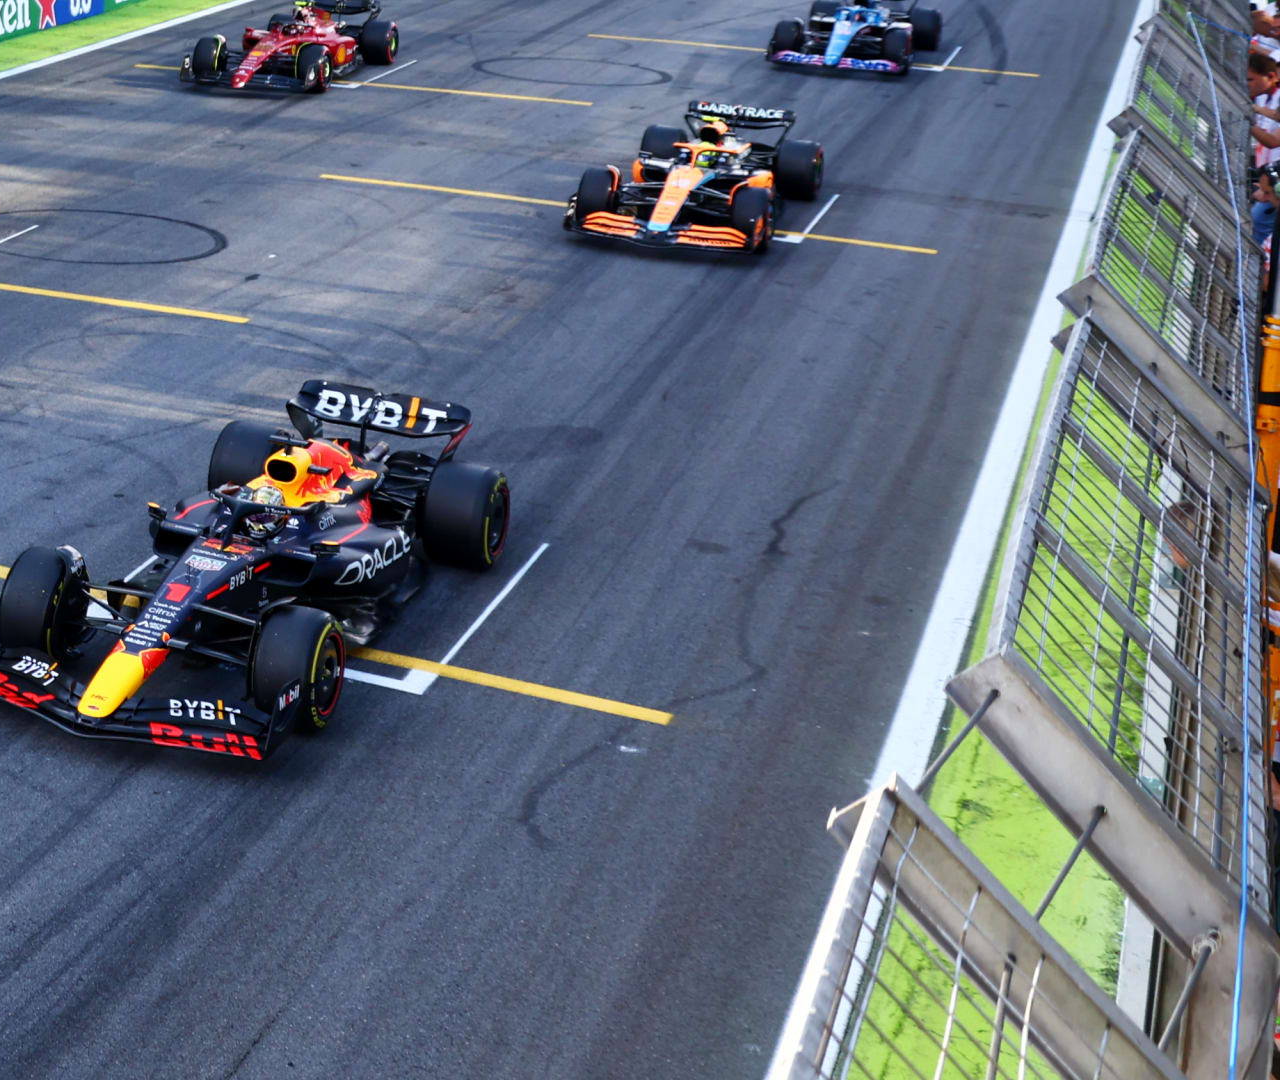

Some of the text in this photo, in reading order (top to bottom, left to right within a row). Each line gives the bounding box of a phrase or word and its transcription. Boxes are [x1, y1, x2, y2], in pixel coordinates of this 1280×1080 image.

[697, 102, 785, 120] DARKTRACE
[315, 389, 448, 434] BYBIT
[334, 525, 412, 586] ORACLE
[229, 565, 255, 591] BYBIT
[148, 606, 178, 618] citrix
[11, 655, 60, 687] BYBIT
[279, 684, 300, 711] Mobil
[169, 698, 241, 726] BYBIT
[149, 721, 263, 761] Bull
